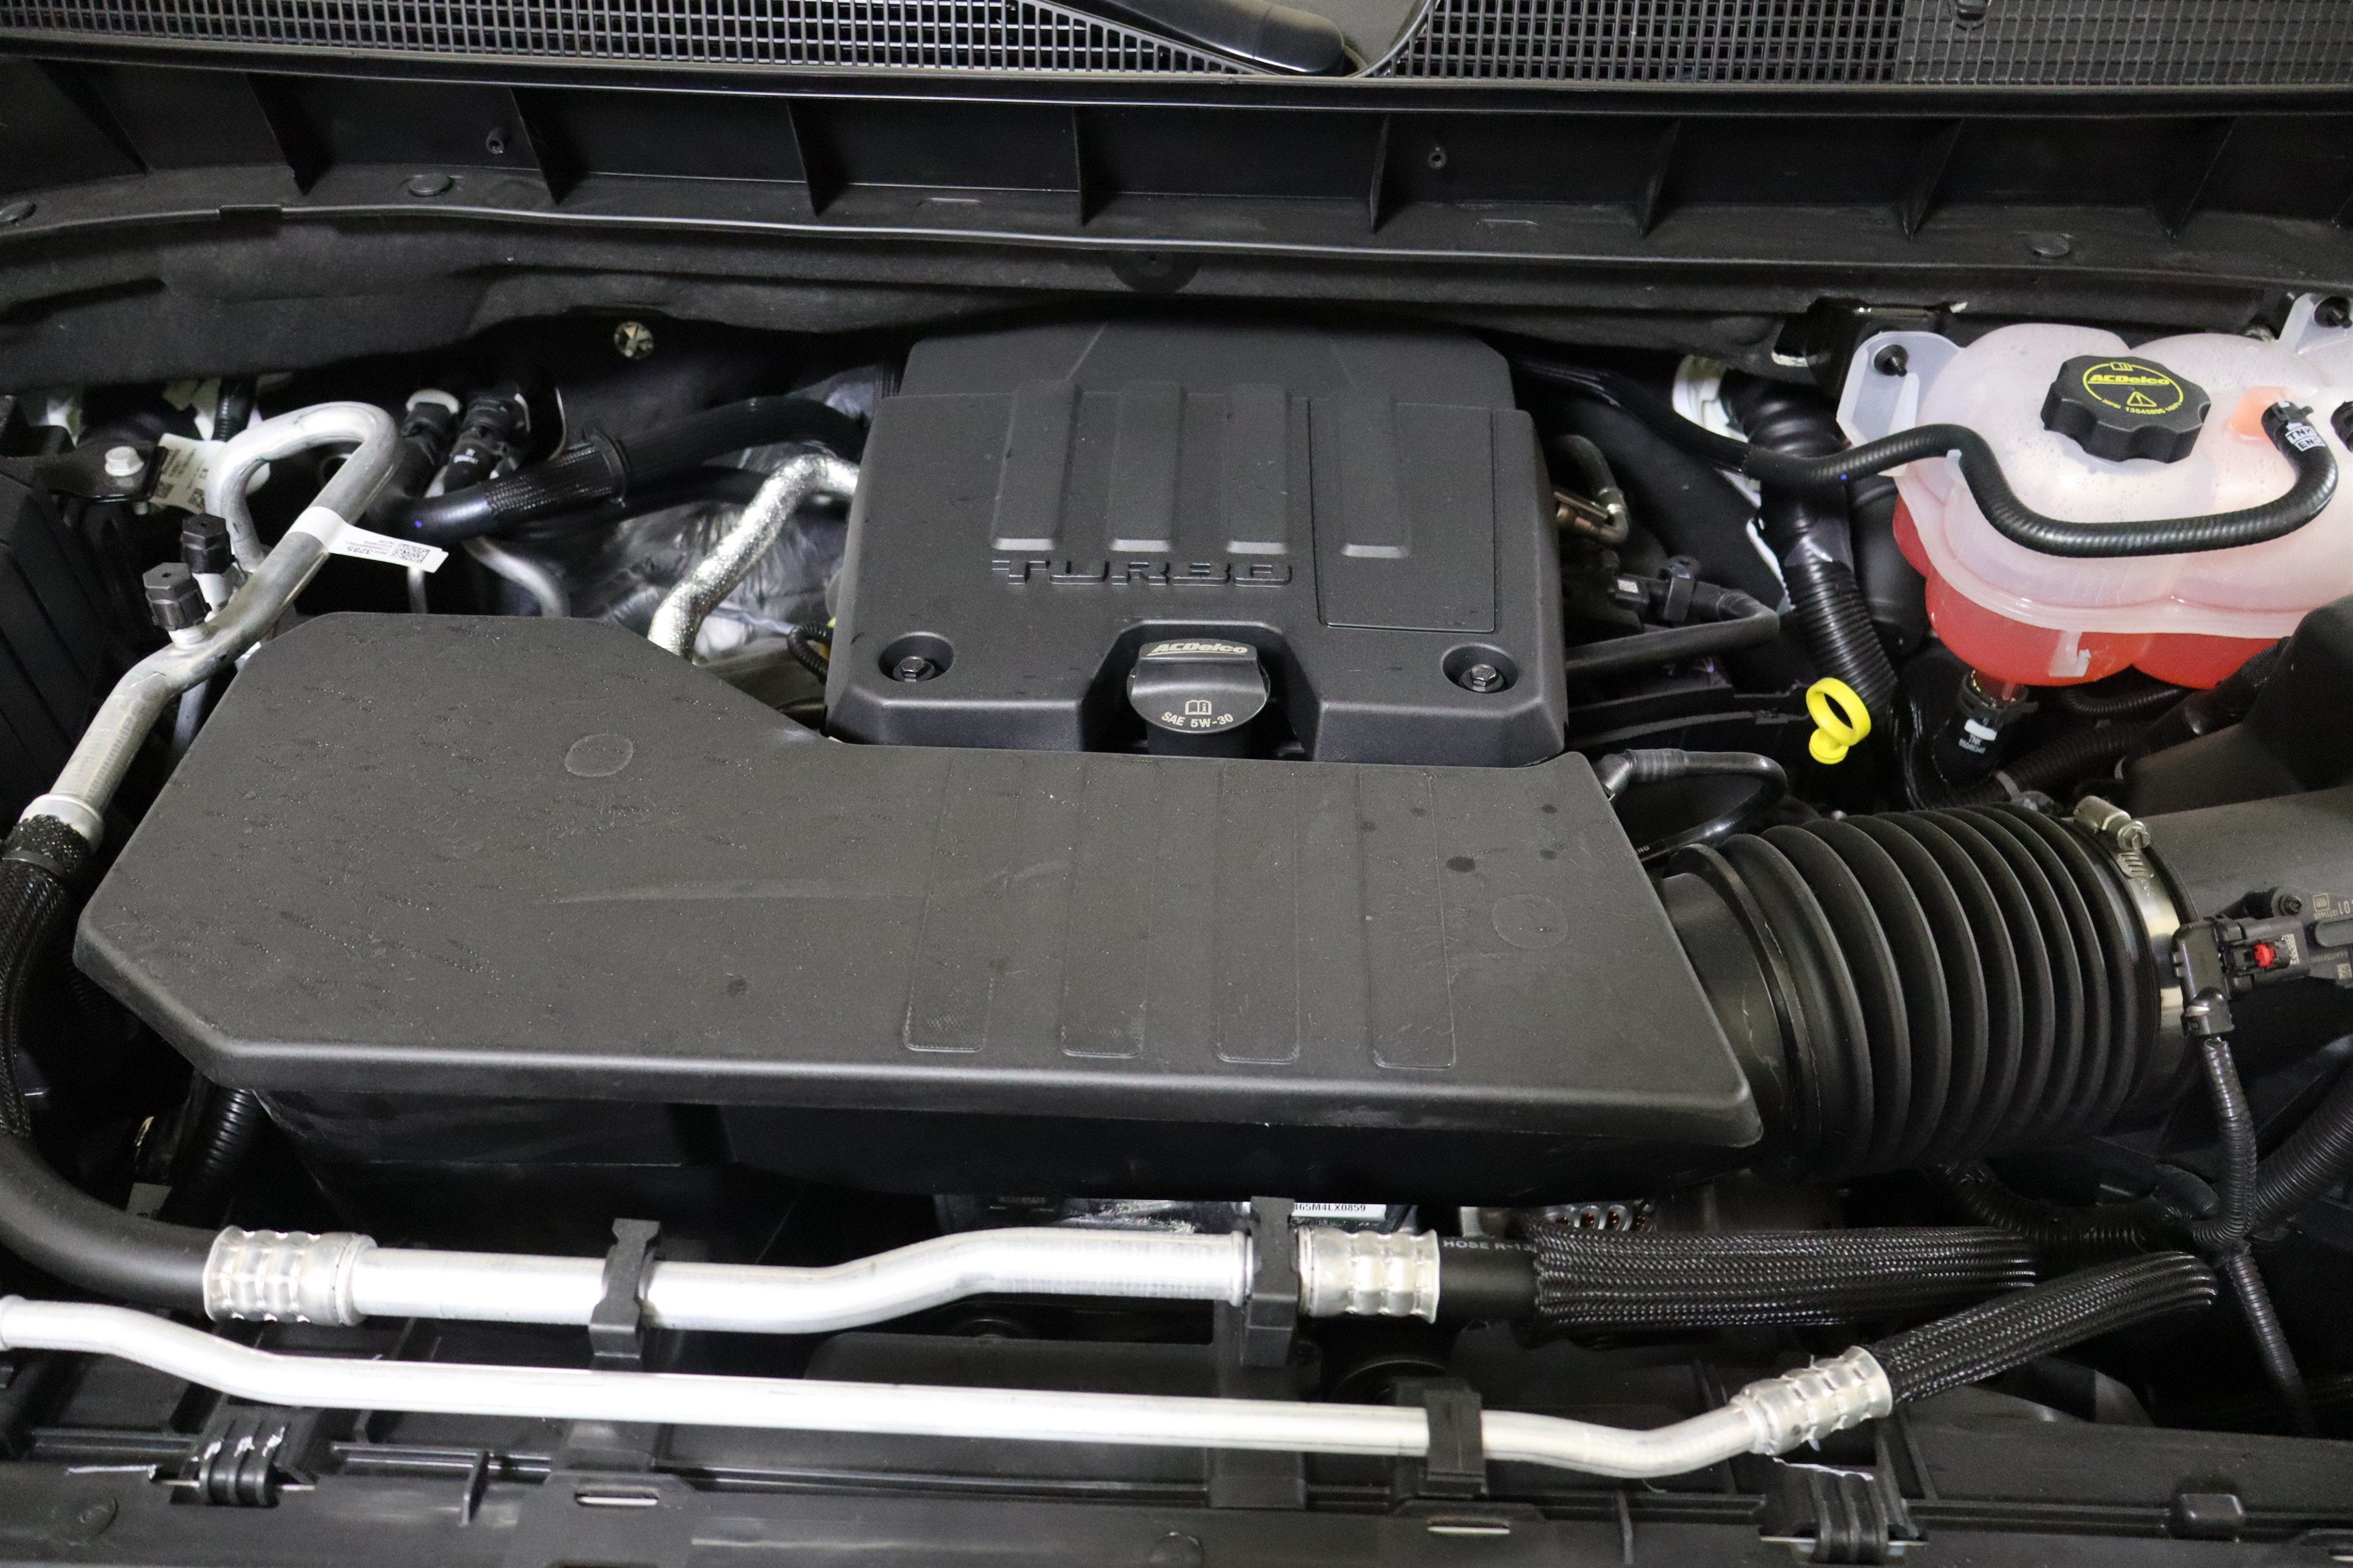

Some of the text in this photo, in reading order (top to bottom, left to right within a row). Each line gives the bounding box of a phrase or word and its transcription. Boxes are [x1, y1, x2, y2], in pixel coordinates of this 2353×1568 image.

[2088, 374, 2170, 385] ACDelco
[992, 559, 1293, 587] TURBO
[1148, 642, 1248, 655] ACDelco
[1161, 712, 1233, 728] SAE 5W-30
[1443, 1240, 1490, 1250] HOSE
